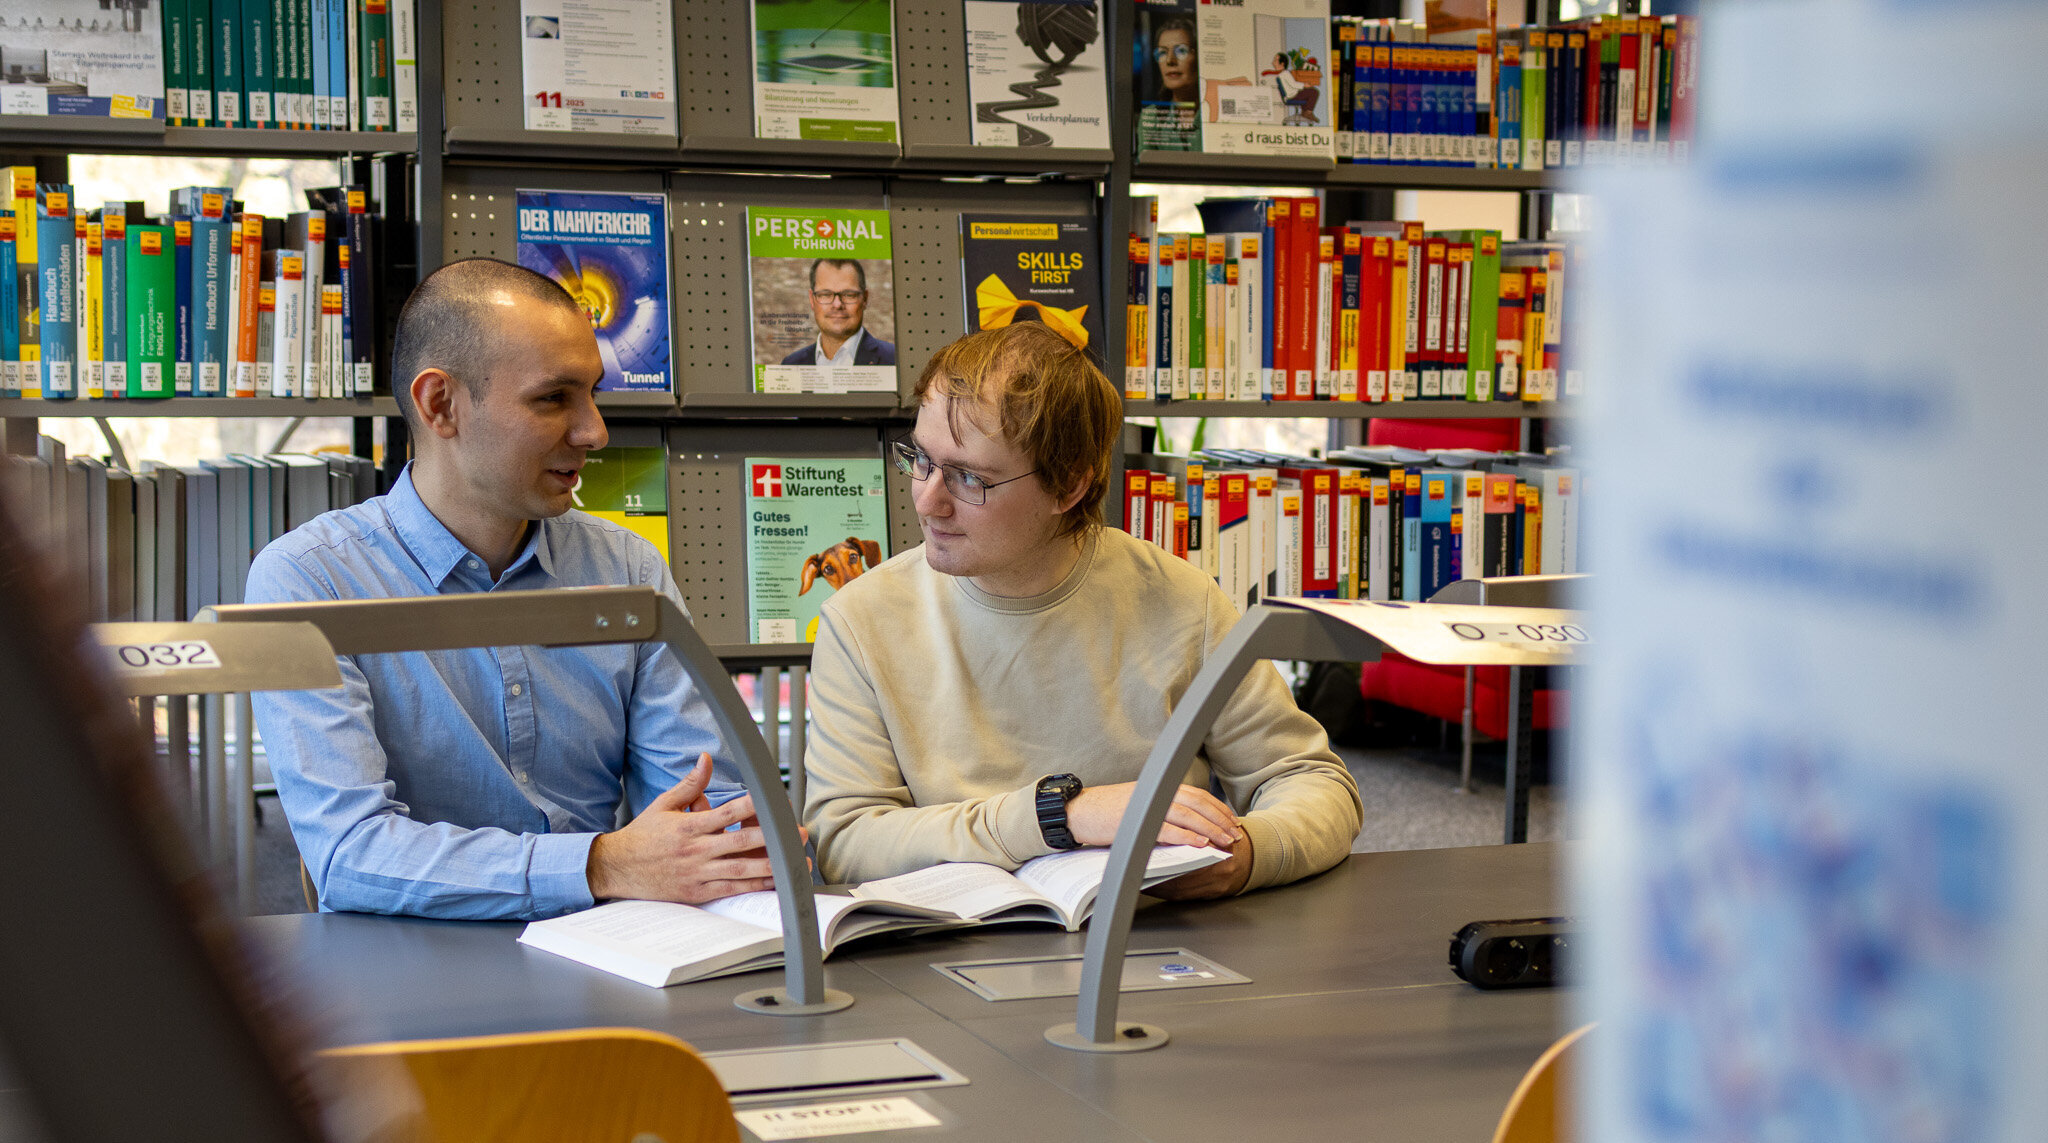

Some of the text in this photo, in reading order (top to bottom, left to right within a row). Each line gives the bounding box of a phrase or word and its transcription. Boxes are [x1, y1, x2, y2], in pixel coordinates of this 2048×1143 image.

[223, 25, 231, 76] Werkstofftechnik
[254, 26, 262, 77] Werkstofftechnik
[535, 91, 562, 109] 11
[566, 99, 584, 107] 2025
[1026, 112, 1100, 126] Verkehrsplanung
[1256, 134, 1283, 145] raus
[1286, 132, 1309, 146] bist
[1311, 134, 1330, 146] Du
[519, 208, 651, 236] DER NAHVERKEHR
[975, 225, 1055, 236] Personalwirtschaft
[553, 235, 598, 243] Personenverkehr
[793, 238, 855, 250] FÜHRUNG
[1017, 251, 1083, 270] SKILLS
[59, 244, 72, 323] Metallschäden
[205, 229, 218, 330] Handbuch Urformen
[1031, 270, 1072, 283] FIRST
[45, 267, 58, 323] Handbuch
[146, 287, 156, 357] Fertigungstechnik
[290, 292, 298, 339] Papiertechnik
[1277, 286, 1285, 349] Projektmanagement
[1302, 287, 1310, 351] Projektmanagement
[156, 312, 164, 357] ENGLISCH
[1162, 308, 1170, 362] Operations Research
[621, 371, 665, 384] Tunnel
[785, 466, 846, 483] Stiftung
[786, 484, 864, 497] Warentest
[624, 494, 643, 507] 11
[753, 511, 791, 523] Gutes
[754, 525, 809, 537] Fressen!
[1516, 623, 1590, 643] 030
[118, 643, 214, 668] 032
[791, 1106, 862, 1122] STOP
